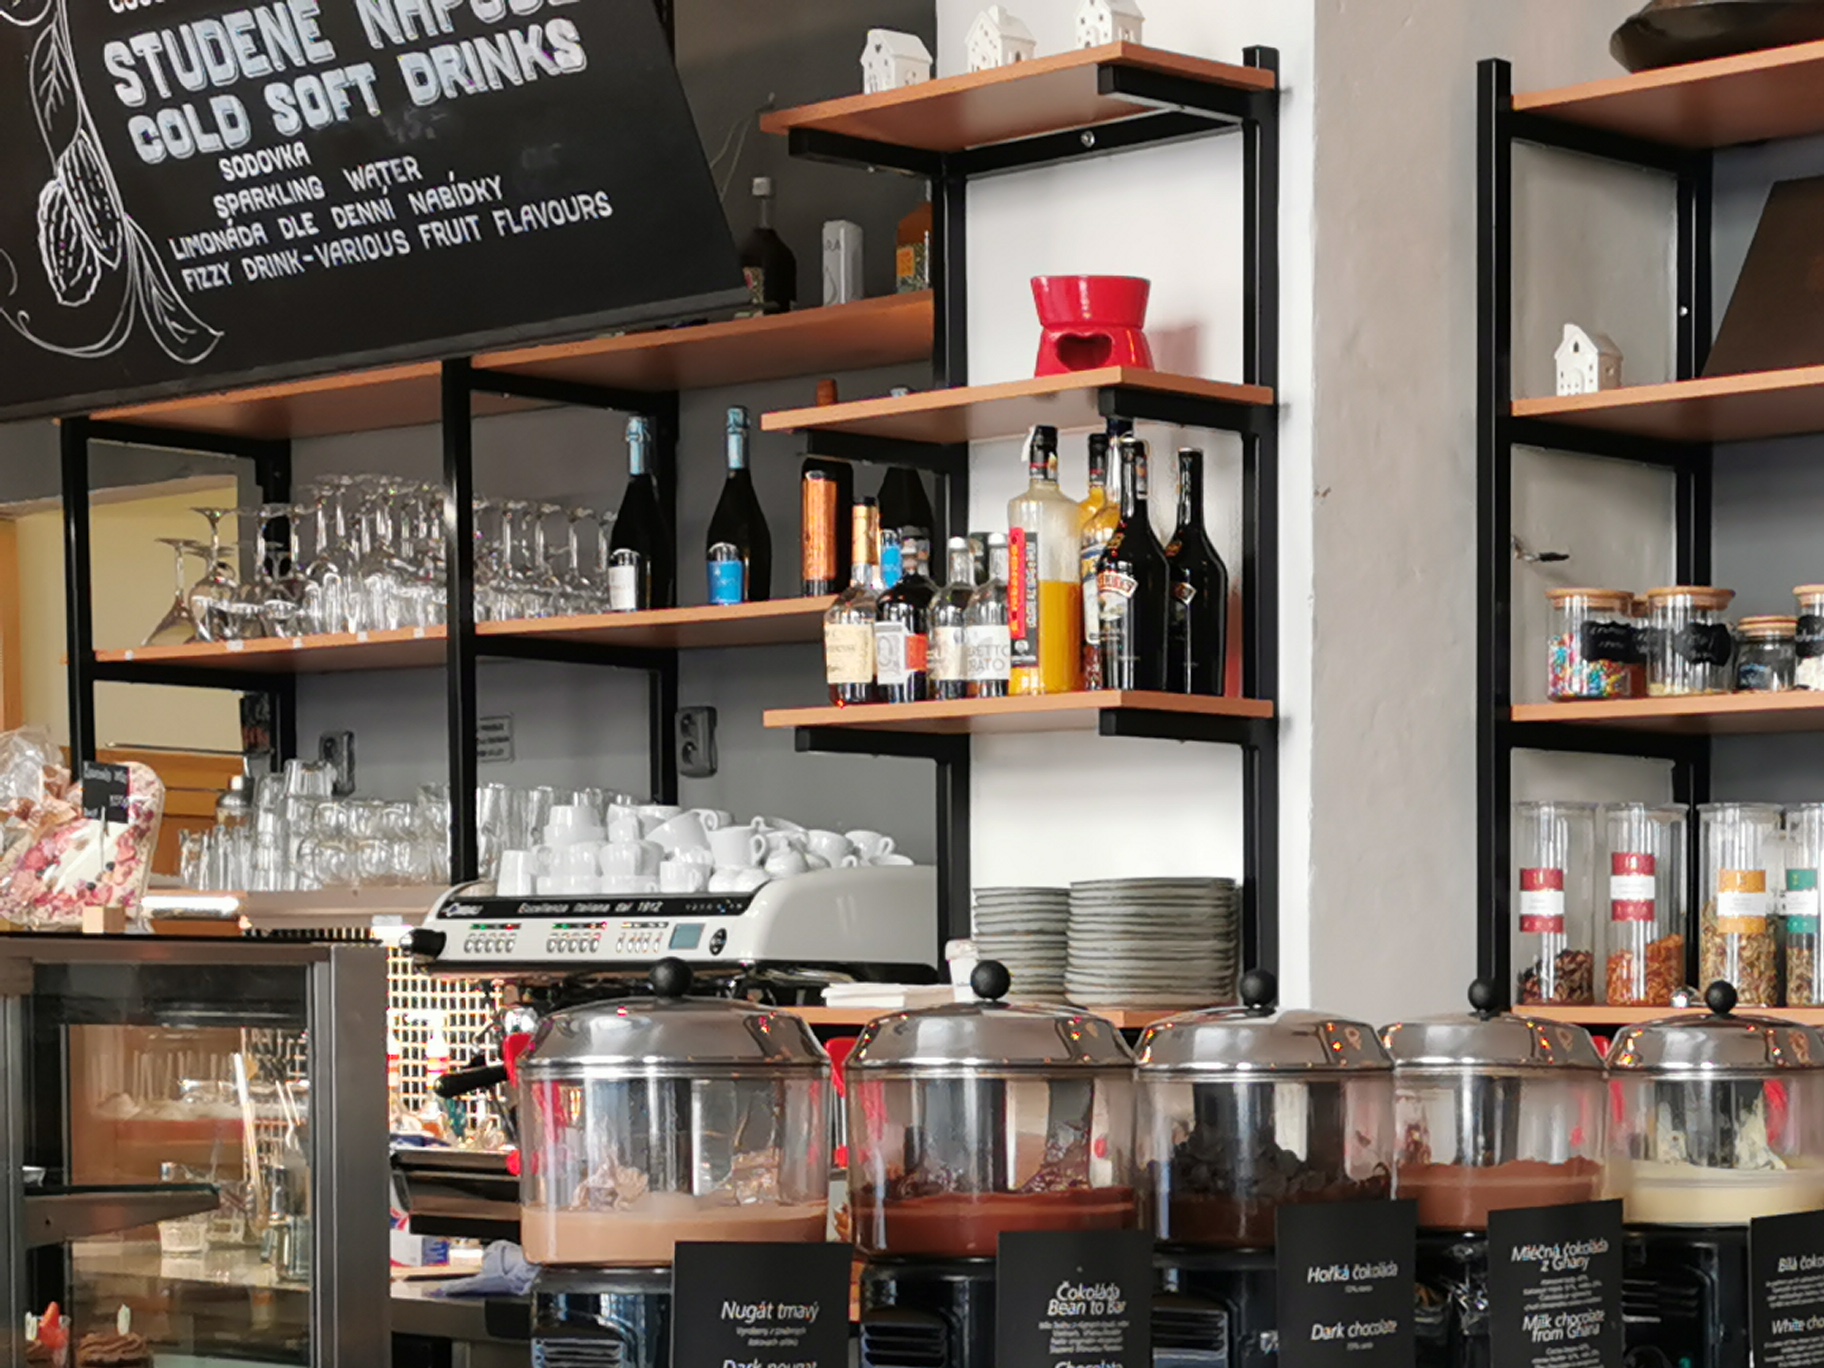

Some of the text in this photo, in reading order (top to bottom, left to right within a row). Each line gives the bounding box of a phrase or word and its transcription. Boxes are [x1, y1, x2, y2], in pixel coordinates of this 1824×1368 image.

[127, 95, 251, 164] COLD
[264, 62, 382, 136] SOFT
[397, 18, 587, 107] DRINKS
[219, 141, 311, 182] SODOVKA
[213, 156, 423, 219] SPARKLING WATER
[169, 171, 503, 261] LIMONÁDA DLE DENNÍ NABÍDKY
[181, 191, 614, 293] FIZZY DRINK-VARIOUS FRUIT FLAVOURS
[1307, 1264, 1349, 1284] Hořká
[1056, 1280, 1121, 1301] Čokoláda
[721, 1300, 819, 1324] Nugát tmavý
[1047, 1298, 1127, 1317] Bean to Bar
[1310, 1319, 1398, 1341] Dark chocolate
[1522, 1314, 1554, 1333] Milk
[1532, 1325, 1564, 1343] from
[1771, 1317, 1805, 1335] White
